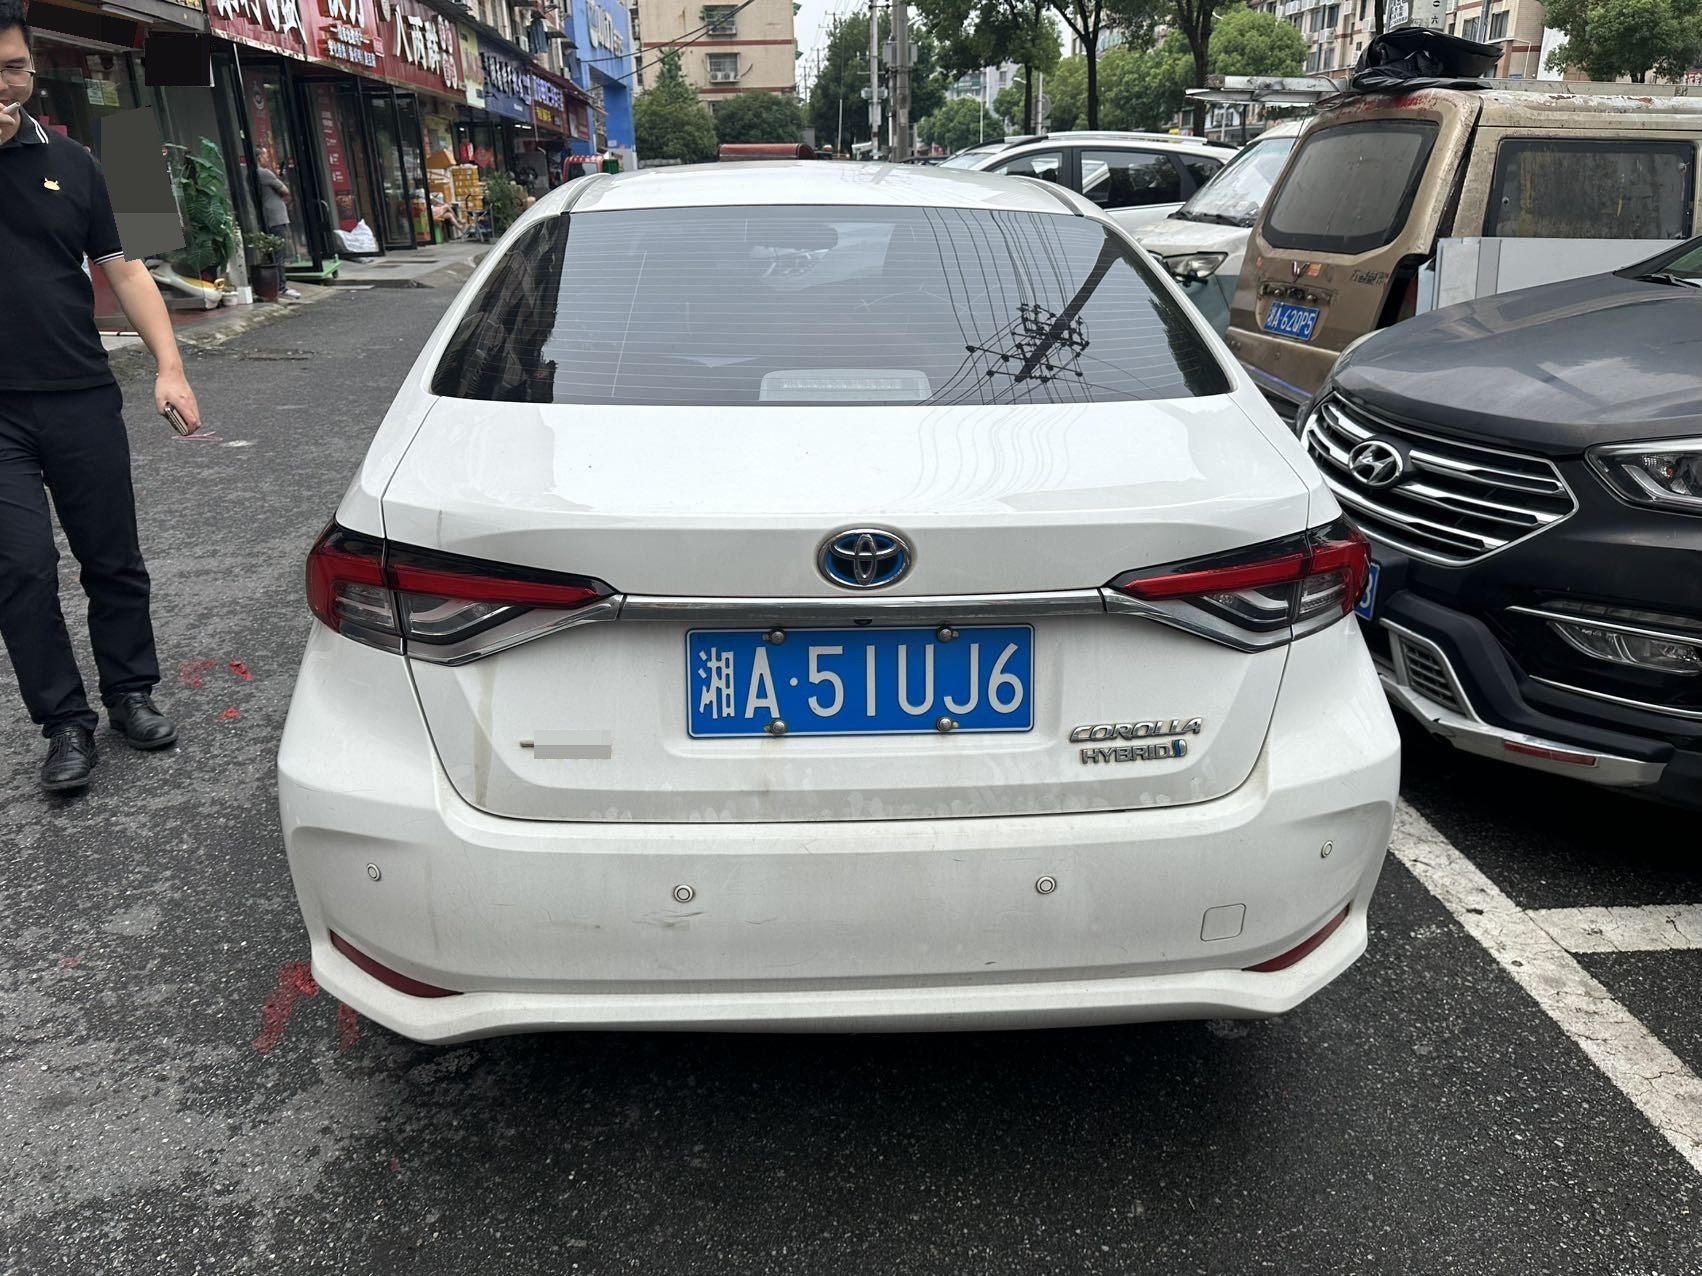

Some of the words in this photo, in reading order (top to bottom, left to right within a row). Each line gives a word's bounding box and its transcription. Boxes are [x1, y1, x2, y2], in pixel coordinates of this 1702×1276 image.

[698, 642, 1024, 720] 湘A·51UJ6
[1069, 717, 1203, 743] COROLLA
[1081, 743, 1172, 764] HYBRID
